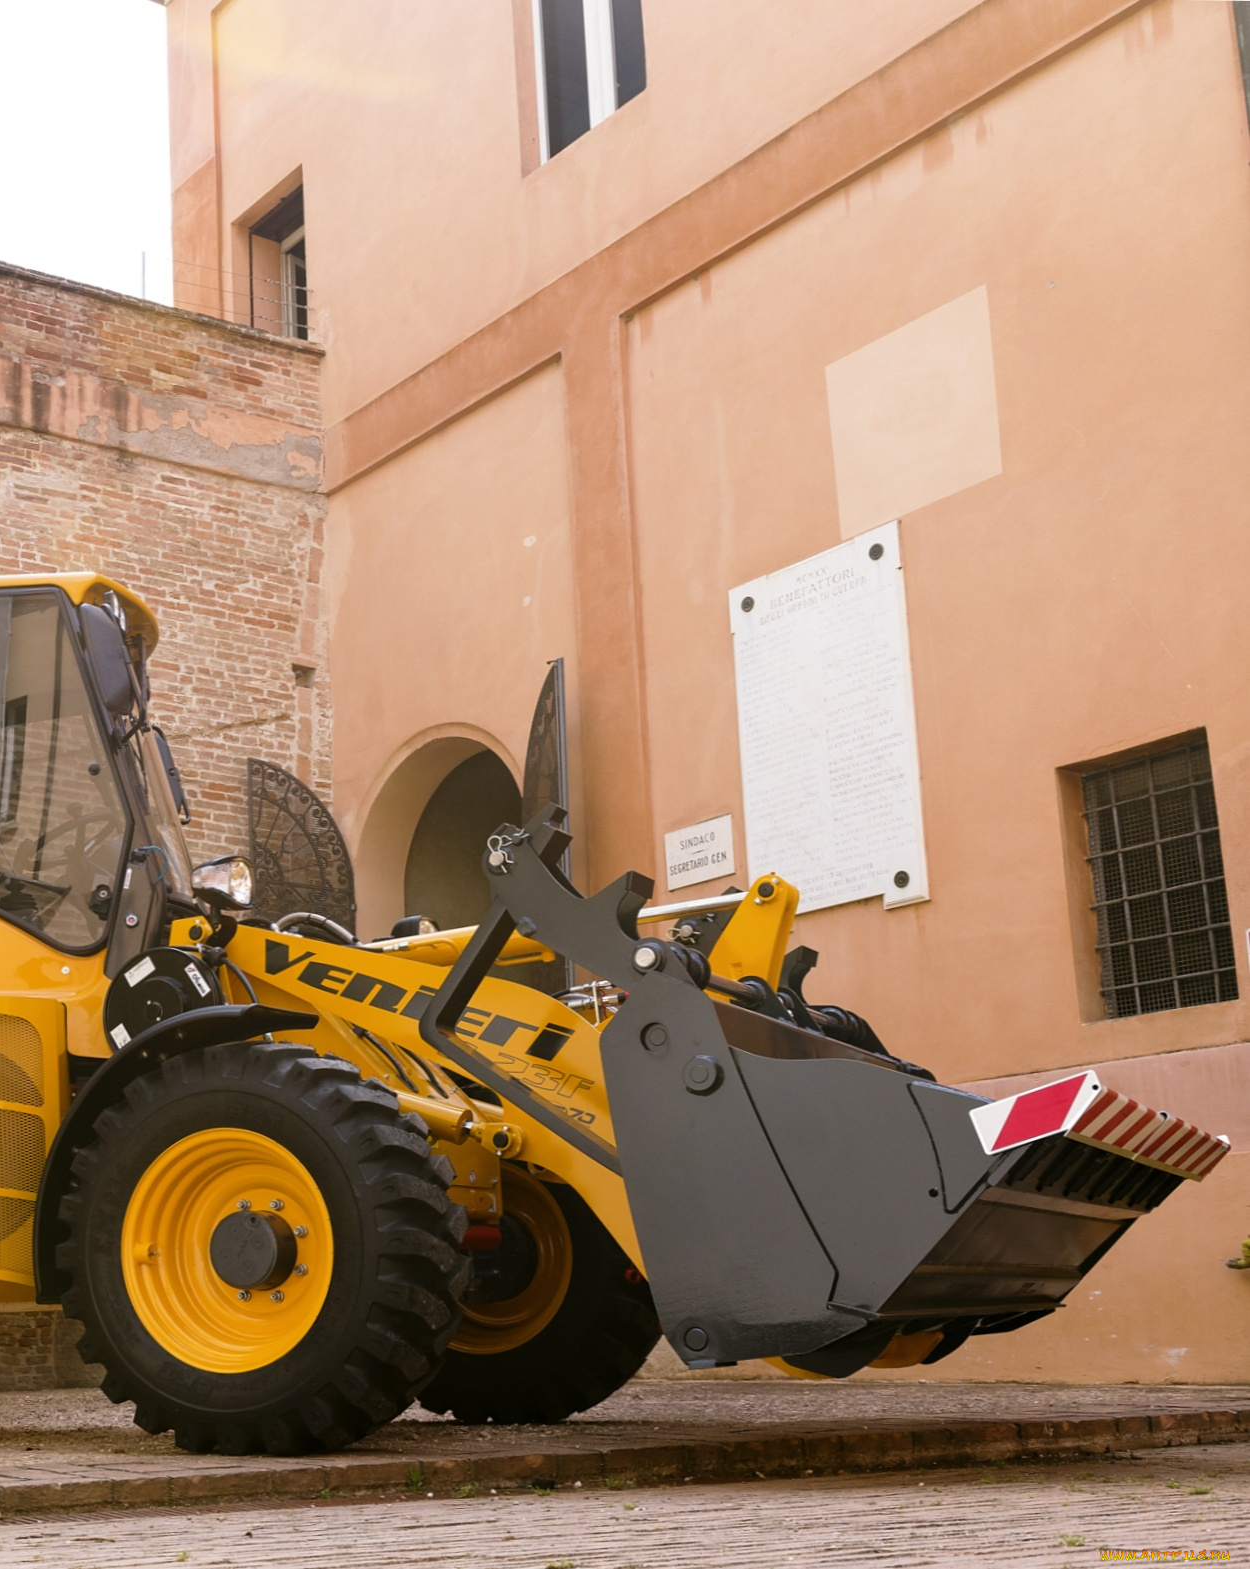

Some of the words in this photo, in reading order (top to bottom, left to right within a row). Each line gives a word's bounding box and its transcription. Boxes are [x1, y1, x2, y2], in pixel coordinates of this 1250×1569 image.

[770, 567, 854, 609] BENEFATTORI
[680, 832, 715, 850] SINDACO
[669, 856, 709, 876] SEGRETARIO
[711, 851, 727, 864] GEN
